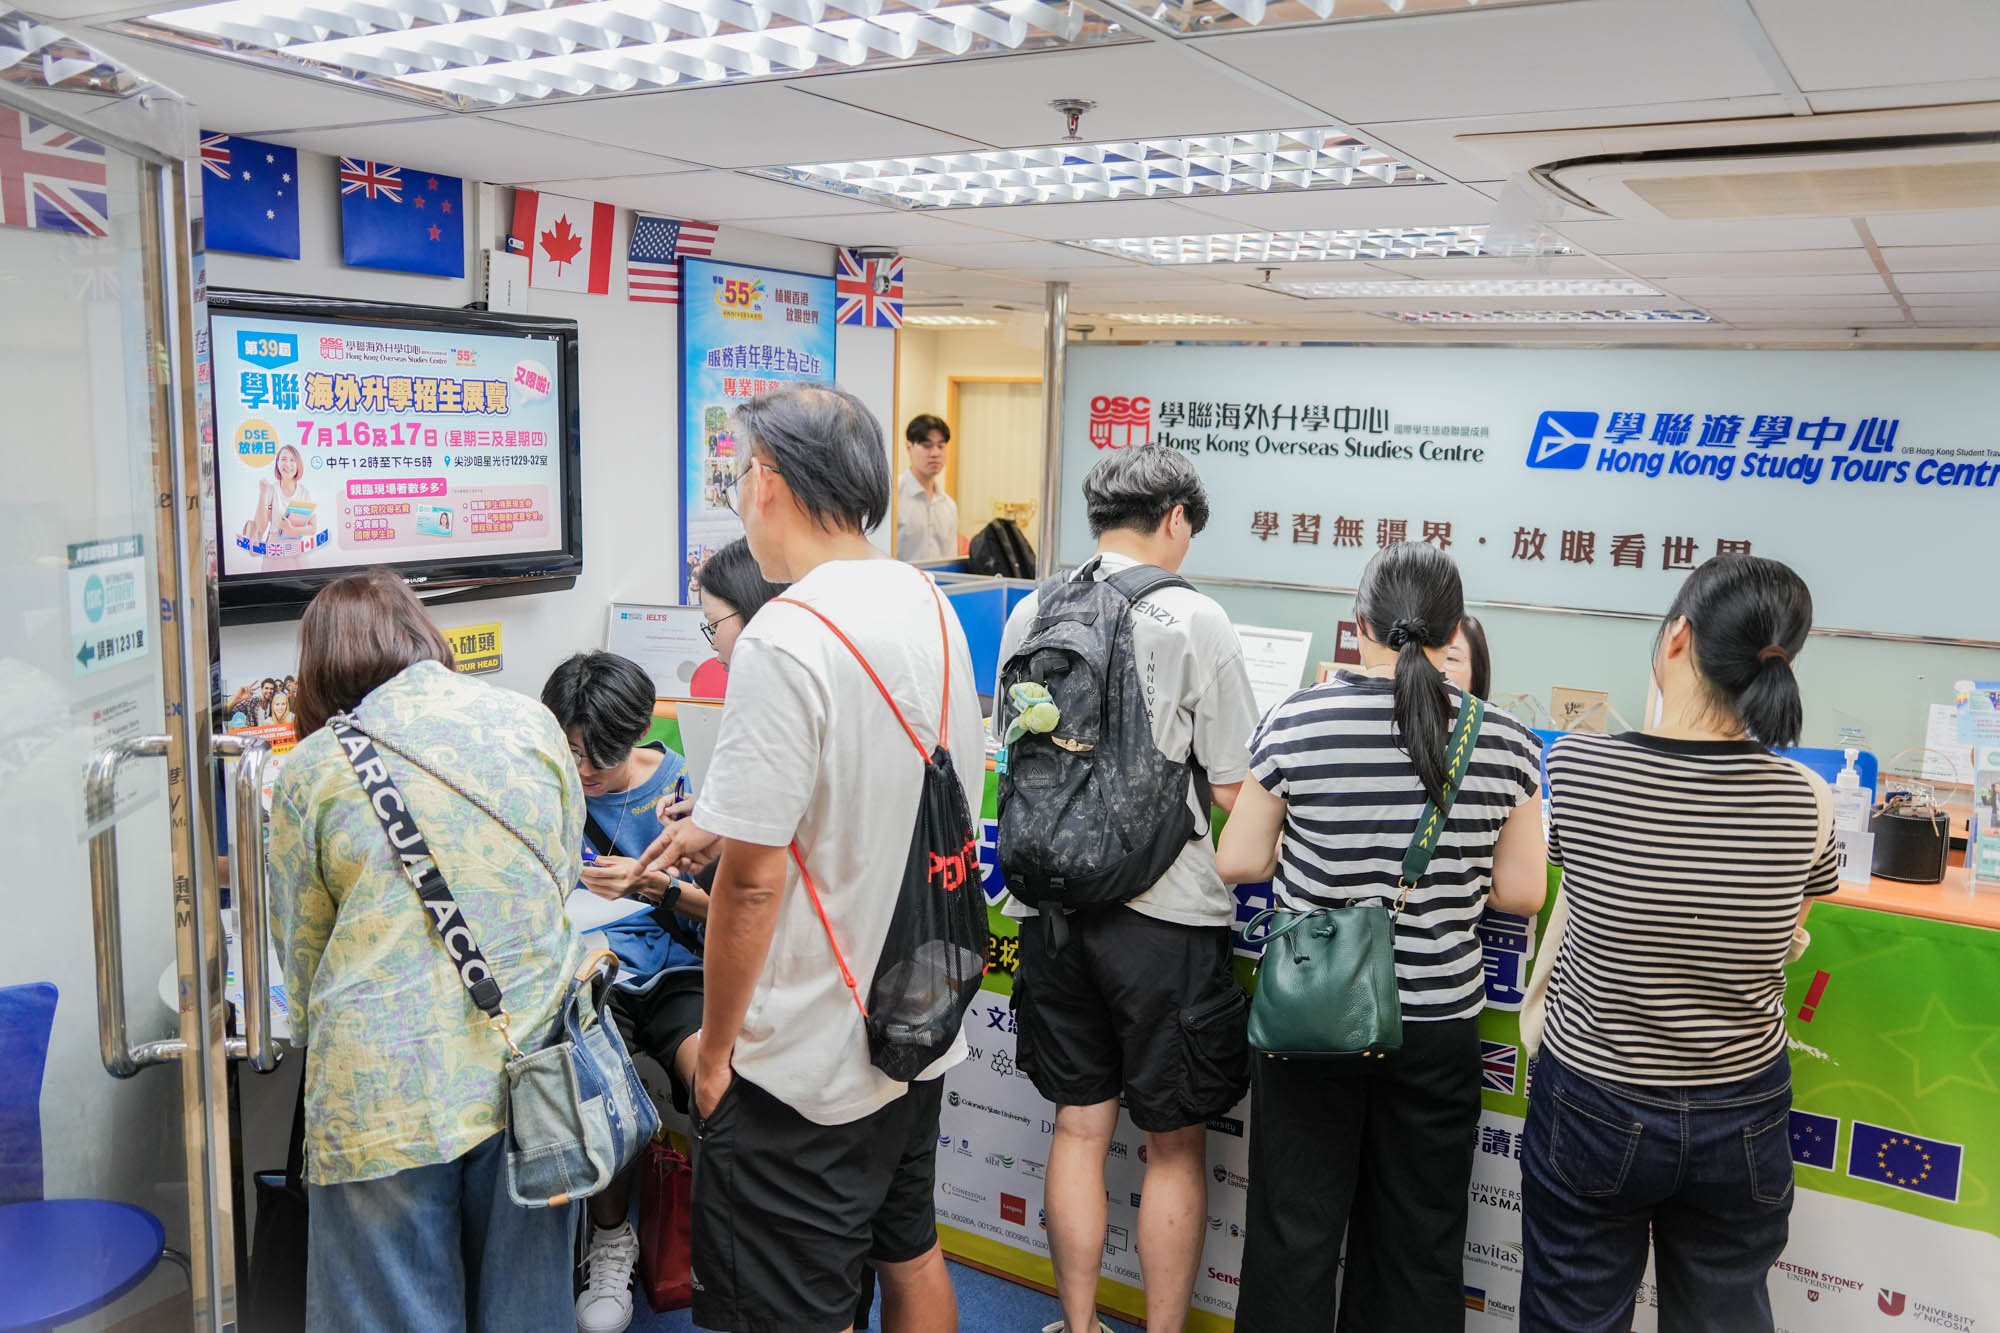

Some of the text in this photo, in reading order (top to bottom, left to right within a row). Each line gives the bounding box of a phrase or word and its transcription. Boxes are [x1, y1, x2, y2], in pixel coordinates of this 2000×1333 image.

[725, 280, 750, 306] 55
[320, 337, 343, 346] OSC
[346, 352, 362, 361] Hong
[363, 353, 379, 362] Kong
[380, 354, 407, 363] Overseas
[408, 355, 428, 364] Studies
[429, 356, 447, 364] Centre
[241, 372, 508, 414] 學聯 海外升學招生展覽
[1091, 396, 1151, 413] OSC
[1159, 401, 1389, 433] 學聯海外升學中心
[244, 430, 269, 440] DSE
[296, 421, 548, 447] 7月16及17日 (星期三及星期四)
[1602, 411, 1900, 453] 學聯遊學中心
[238, 441, 275, 454] 放榜日
[1158, 432, 1484, 463] Hong Kong Overseas Studies Centre
[1916, 448, 1934, 456] Hong
[1936, 448, 1954, 457] Kong
[1956, 448, 1984, 457] Student
[326, 456, 432, 468] 中午12時至下午5時
[454, 455, 548, 467] 尖沙咀星光行1229-32室
[1596, 448, 2000, 487] Hong Kong Study Tours Centr
[1134, 600, 1181, 627] ENZY
[477, 659, 498, 669] HEAD
[962, 1098, 1031, 1127] Colorado State University
[1472, 1182, 1521, 1201] UNIVERS
[1471, 1191, 1521, 1213] TASMA
[1464, 1241, 1518, 1264] navitas
[1208, 1267, 1242, 1287] Sene
[1786, 1273, 1843, 1294] UNIVERSITY
[1821, 1273, 1864, 1291] SYDNEY
[1488, 1299, 1515, 1313] holland
[1914, 1302, 1976, 1327] UNIVERSITY
[1923, 1314, 1972, 1333] NICOSIA
